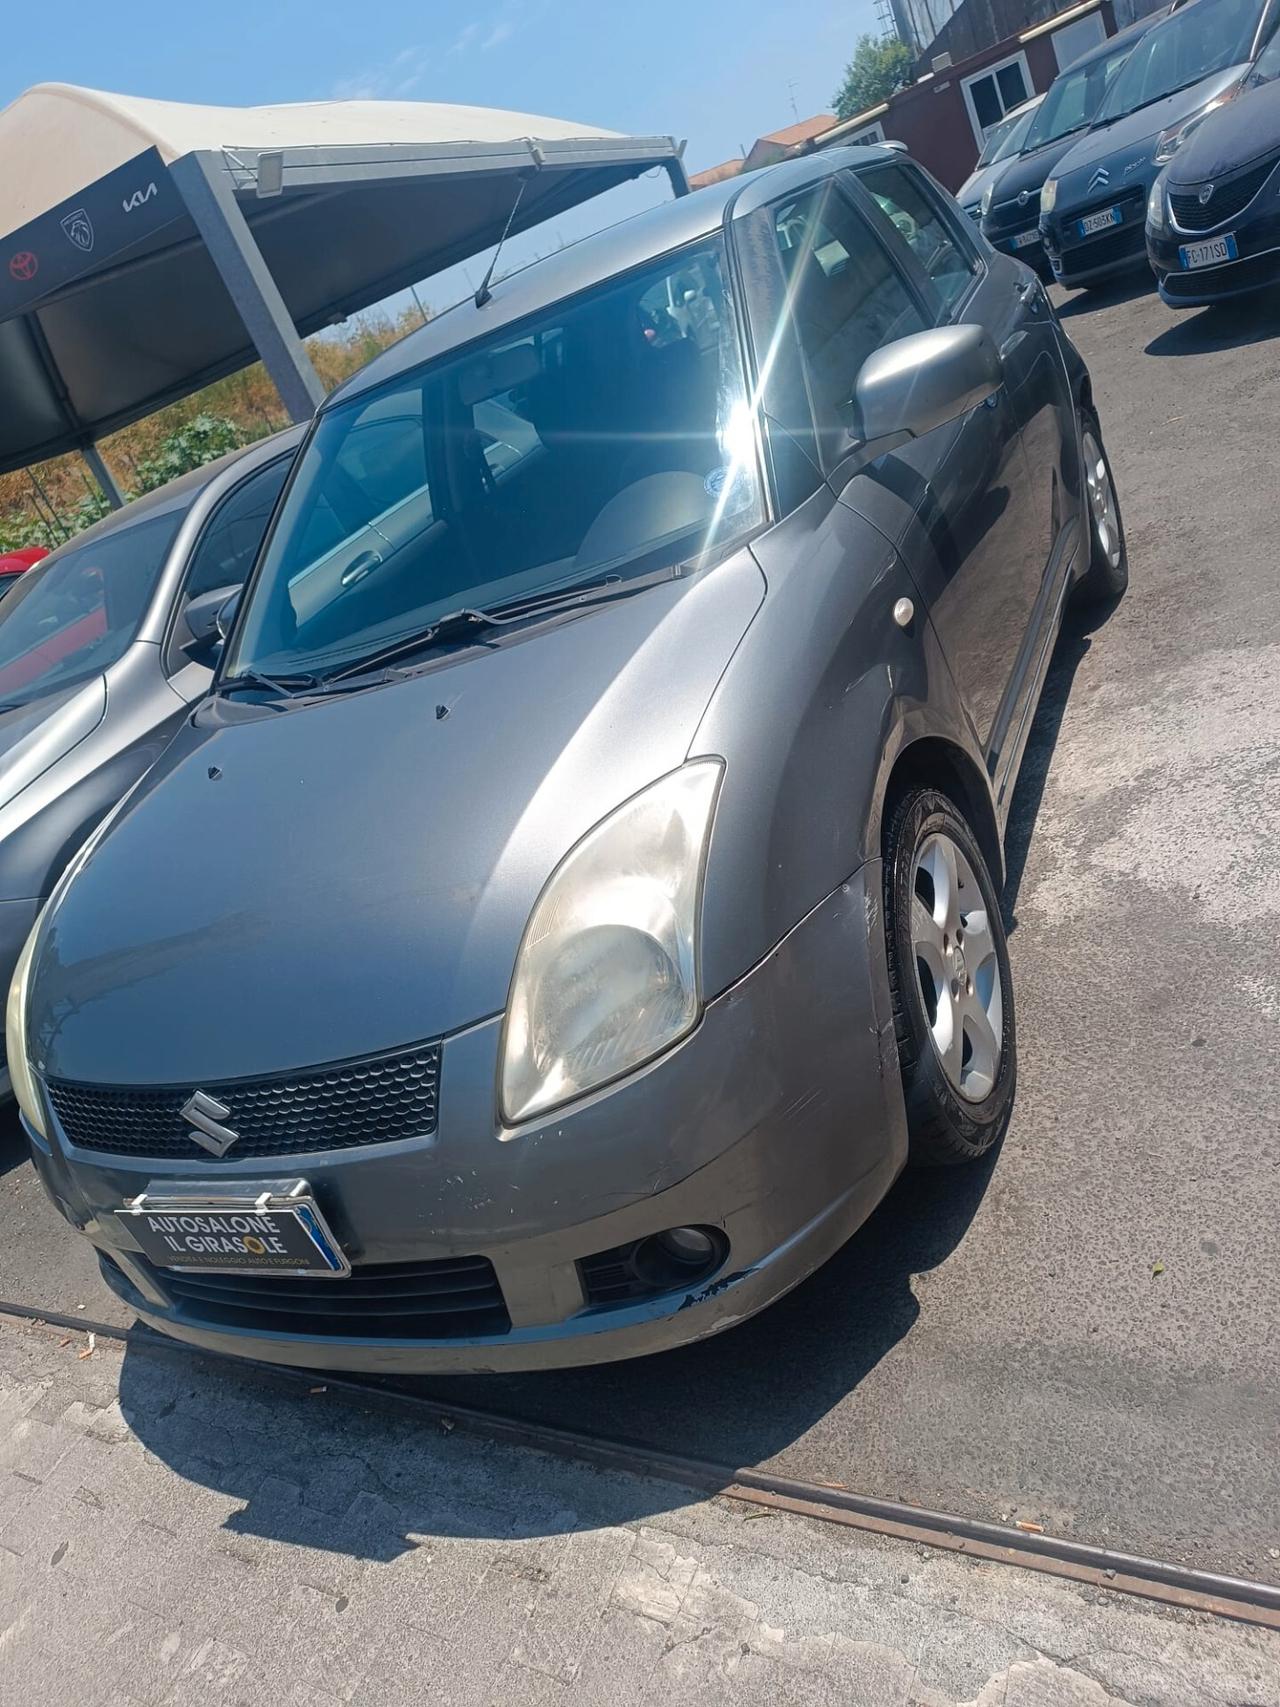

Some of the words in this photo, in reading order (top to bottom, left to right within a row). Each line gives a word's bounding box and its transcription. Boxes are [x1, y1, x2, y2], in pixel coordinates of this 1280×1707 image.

[147, 1216, 281, 1233] AUTOSALONE
[163, 1236, 187, 1252] IL
[186, 1236, 288, 1255] GIRASOLE
